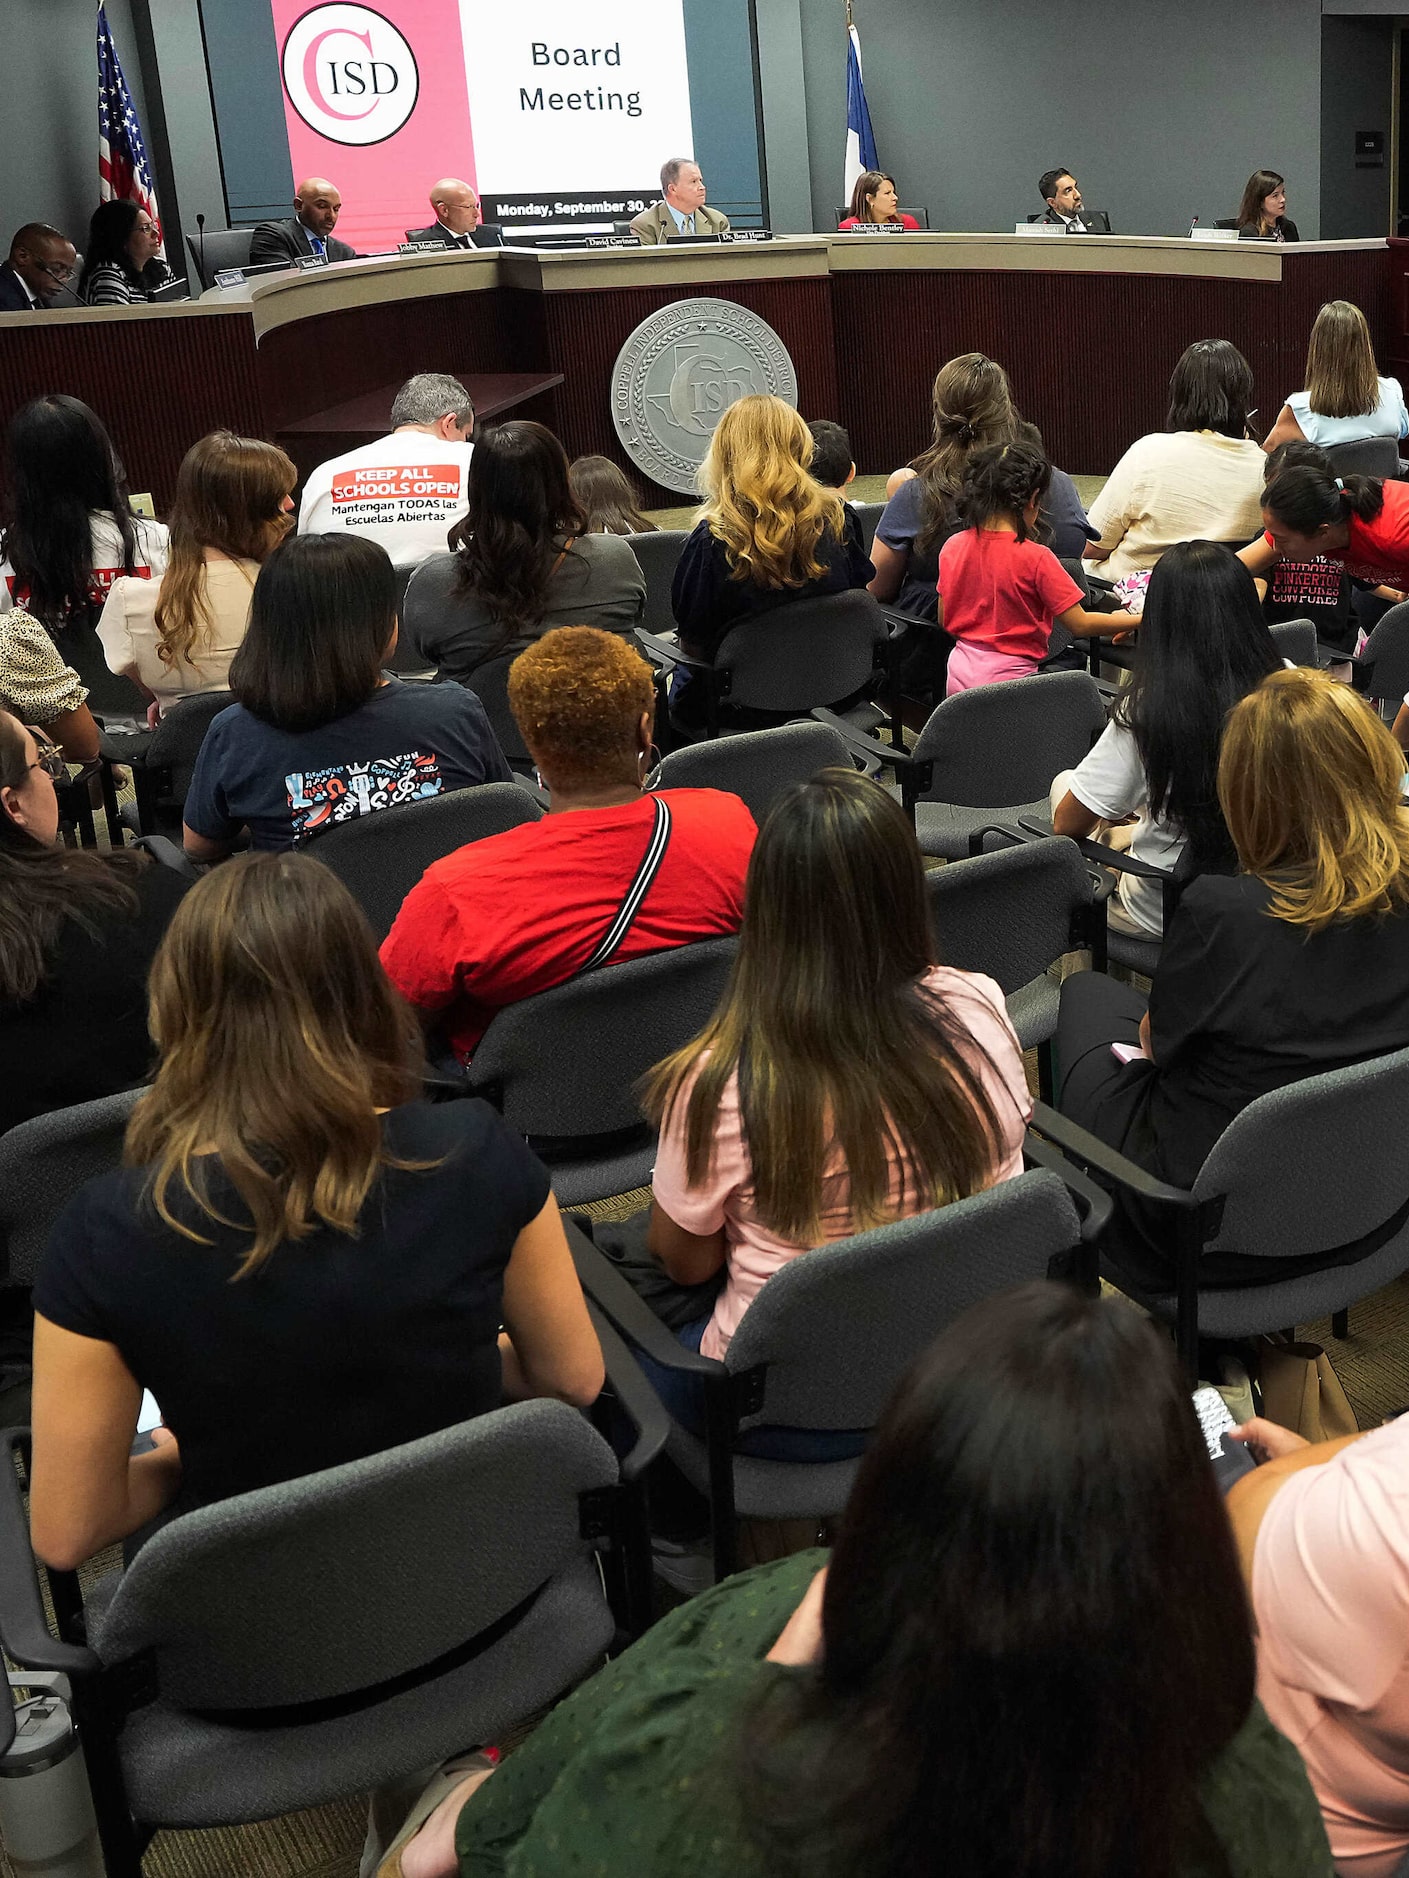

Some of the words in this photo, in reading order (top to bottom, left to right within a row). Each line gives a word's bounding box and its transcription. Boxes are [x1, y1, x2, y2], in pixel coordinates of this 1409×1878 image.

[531, 42, 621, 66] Board
[519, 86, 643, 117] Meeting
[496, 204, 553, 217] Monday,
[554, 201, 625, 216] September
[627, 200, 648, 213] 30,
[722, 232, 733, 240] Dr.
[734, 232, 748, 240] Brad
[749, 231, 766, 239] Hunt
[852, 224, 878, 232] Nichole
[879, 224, 904, 232] Bentley
[419, 242, 444, 250] Mathew
[589, 238, 609, 246] David
[617, 349, 638, 410] COPPELL
[638, 304, 717, 350] INDEPENDENT
[721, 307, 765, 341] SCHOOL
[767, 340, 793, 399] DISTRICT
[636, 449, 681, 485] BOARD
[355, 470, 397, 482] KEEP
[400, 468, 433, 480] ALL
[333, 482, 410, 499] SCHOOLS
[413, 481, 459, 494] OPEN
[331, 501, 394, 515] Mantengan
[397, 499, 440, 509] TODAS
[442, 499, 457, 509] las
[345, 513, 394, 526] Escuelas
[396, 511, 446, 522] Abiertas
[1274, 572, 1342, 587] PINKERTON
[395, 751, 419, 762] FUN
[371, 763, 400, 779] COPPELL
[303, 783, 323, 798] PLAY
